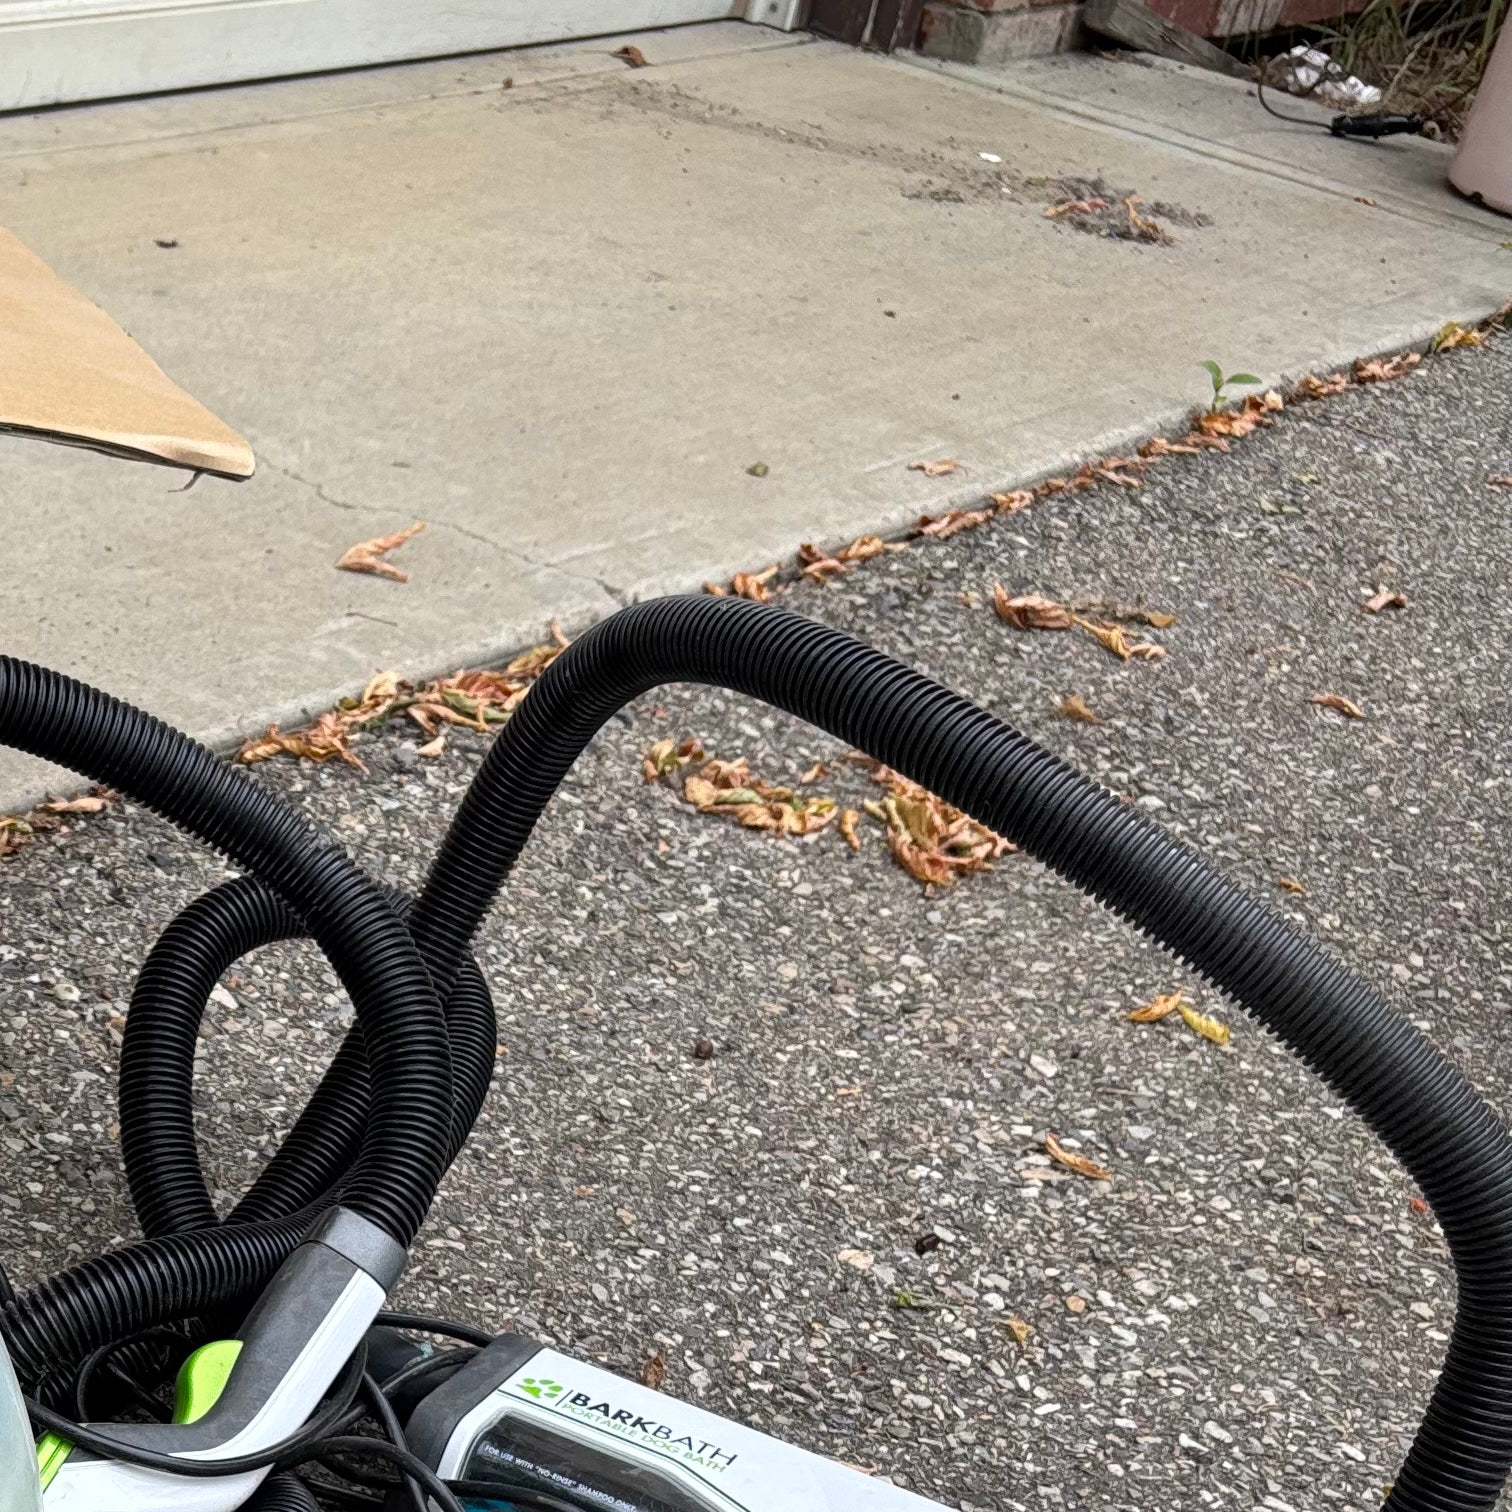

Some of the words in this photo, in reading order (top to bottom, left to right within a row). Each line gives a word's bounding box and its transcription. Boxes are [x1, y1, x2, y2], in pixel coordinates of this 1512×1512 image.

[515, 1457, 534, 1470] WITH
[562, 1403, 639, 1438] PORTABLE
[641, 1434, 681, 1454] DOG
[683, 1451, 727, 1473] BATH
[569, 1392, 738, 1466] BARKBATH
